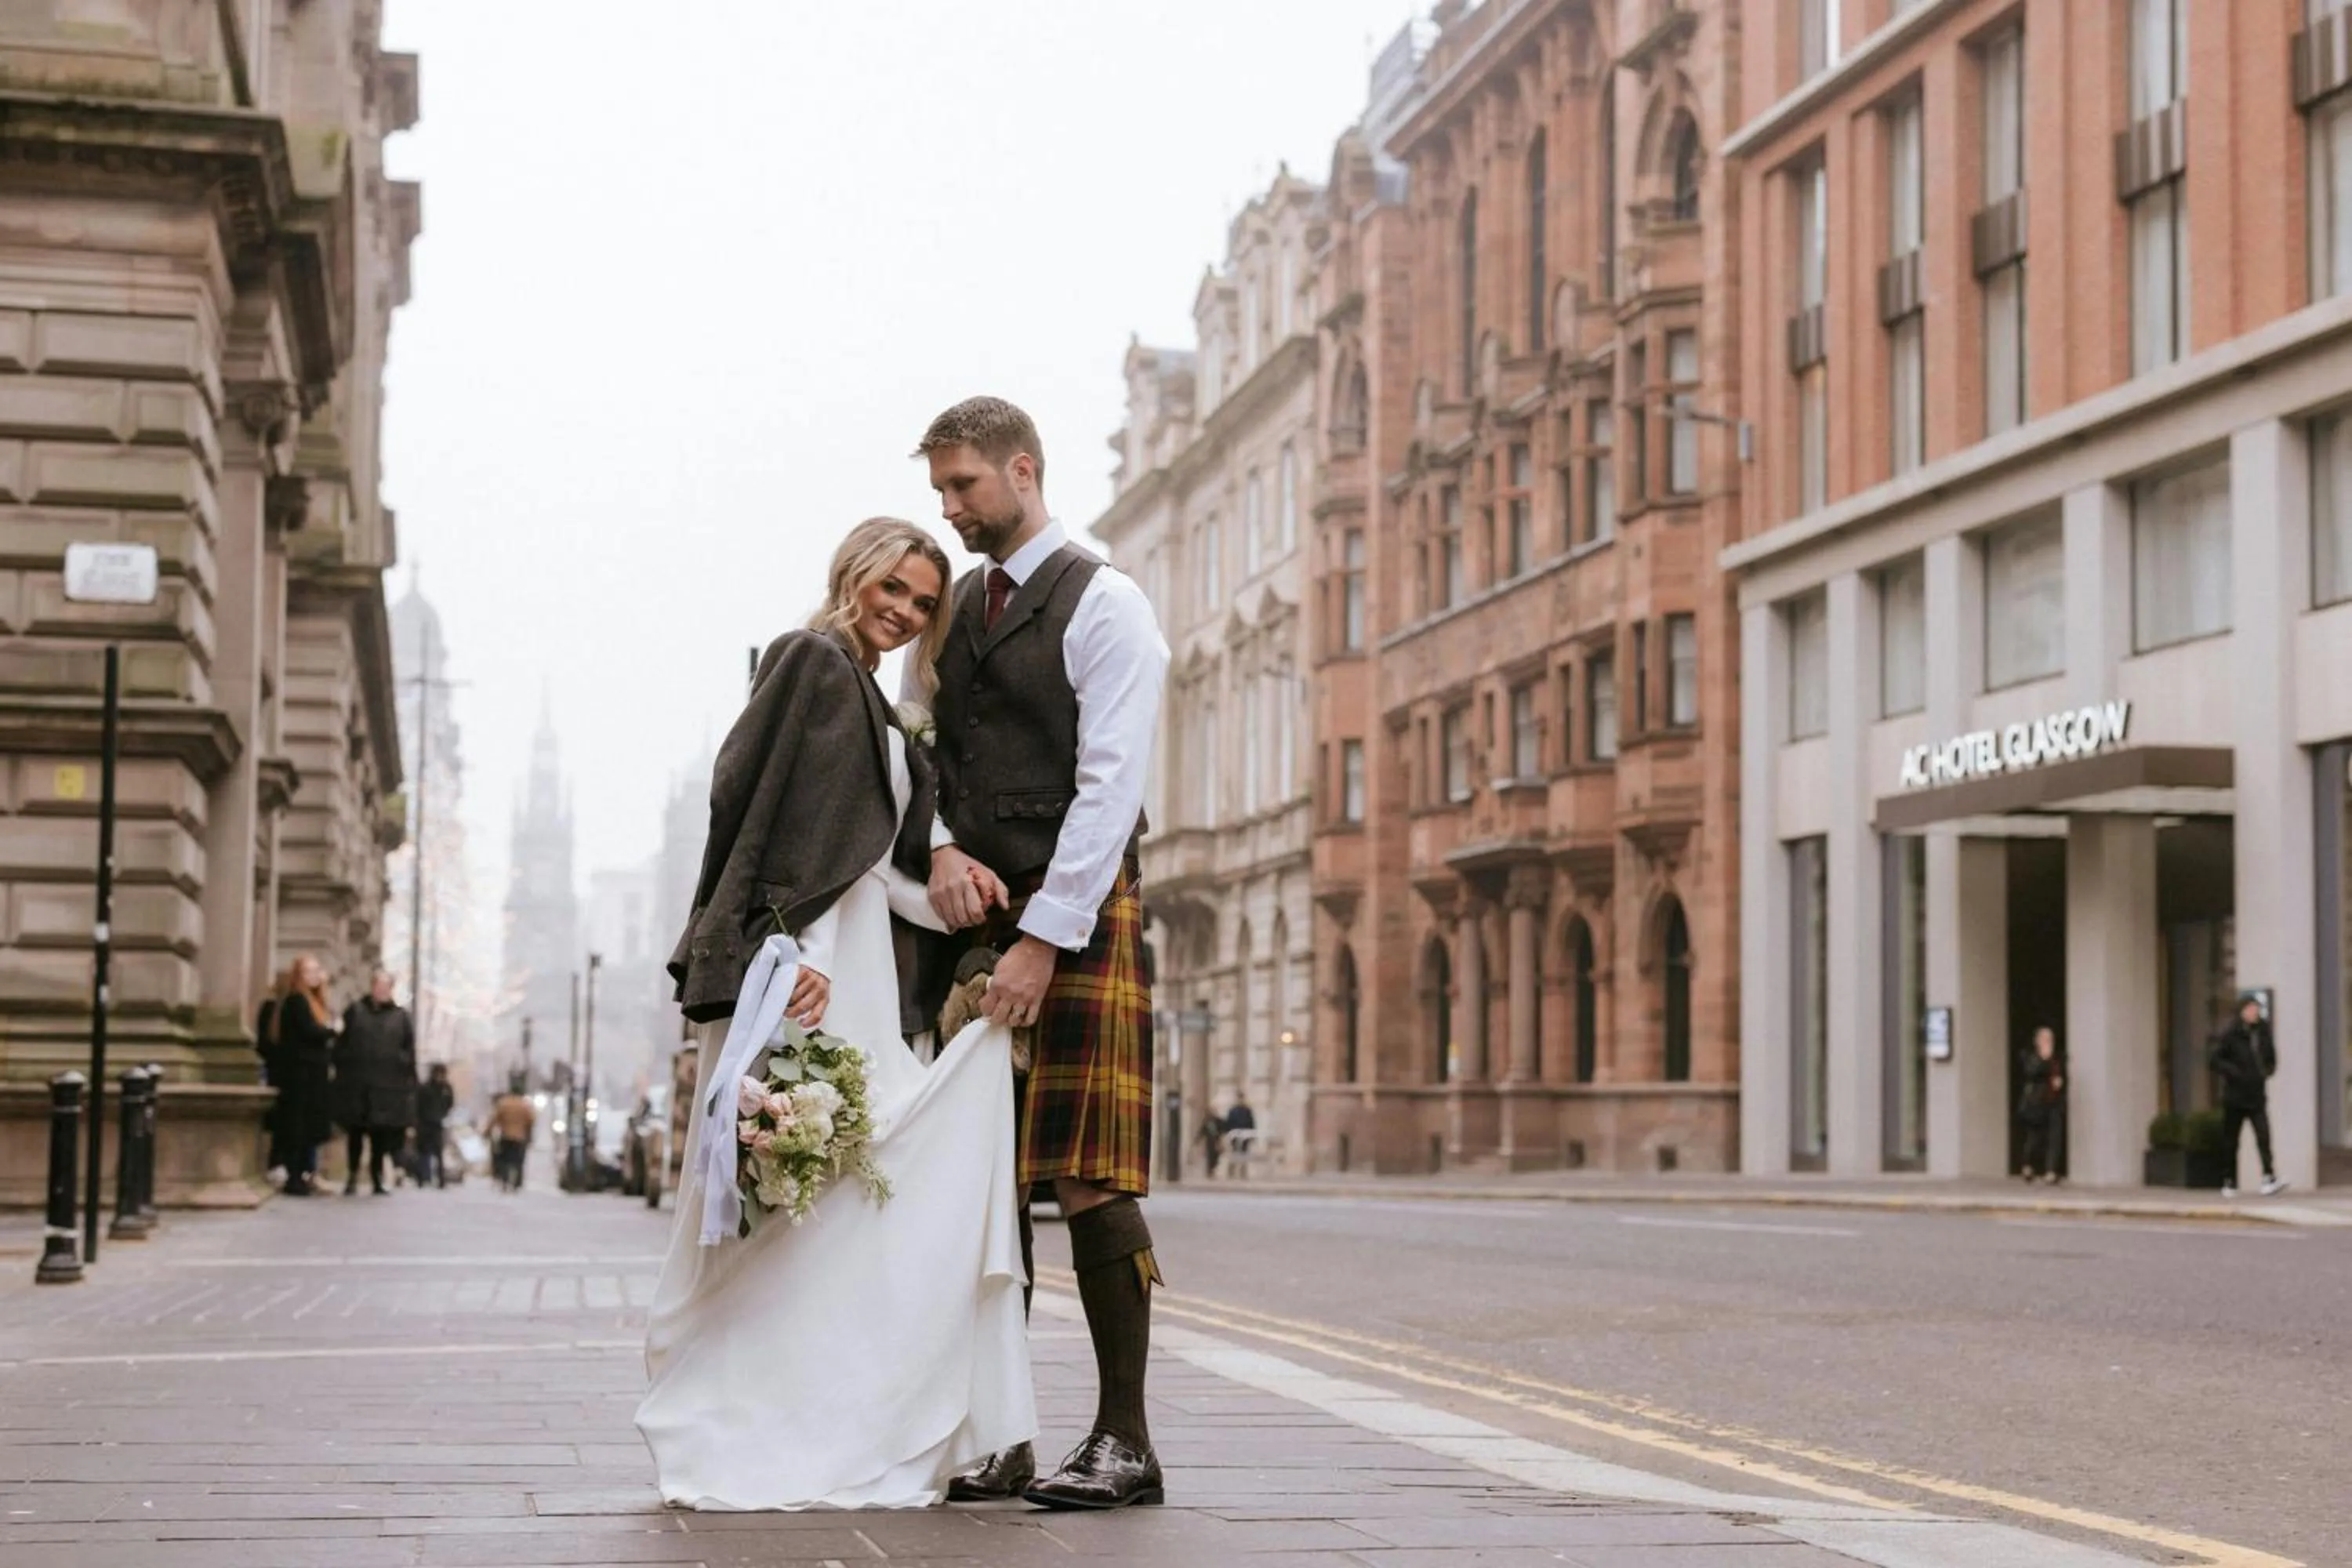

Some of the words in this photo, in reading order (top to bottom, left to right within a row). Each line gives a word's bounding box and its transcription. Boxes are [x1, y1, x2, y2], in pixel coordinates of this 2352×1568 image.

[1901, 744, 1930, 787] AC
[1931, 730, 2001, 785] HOTEL
[2002, 699, 2129, 768] GLASGOW
